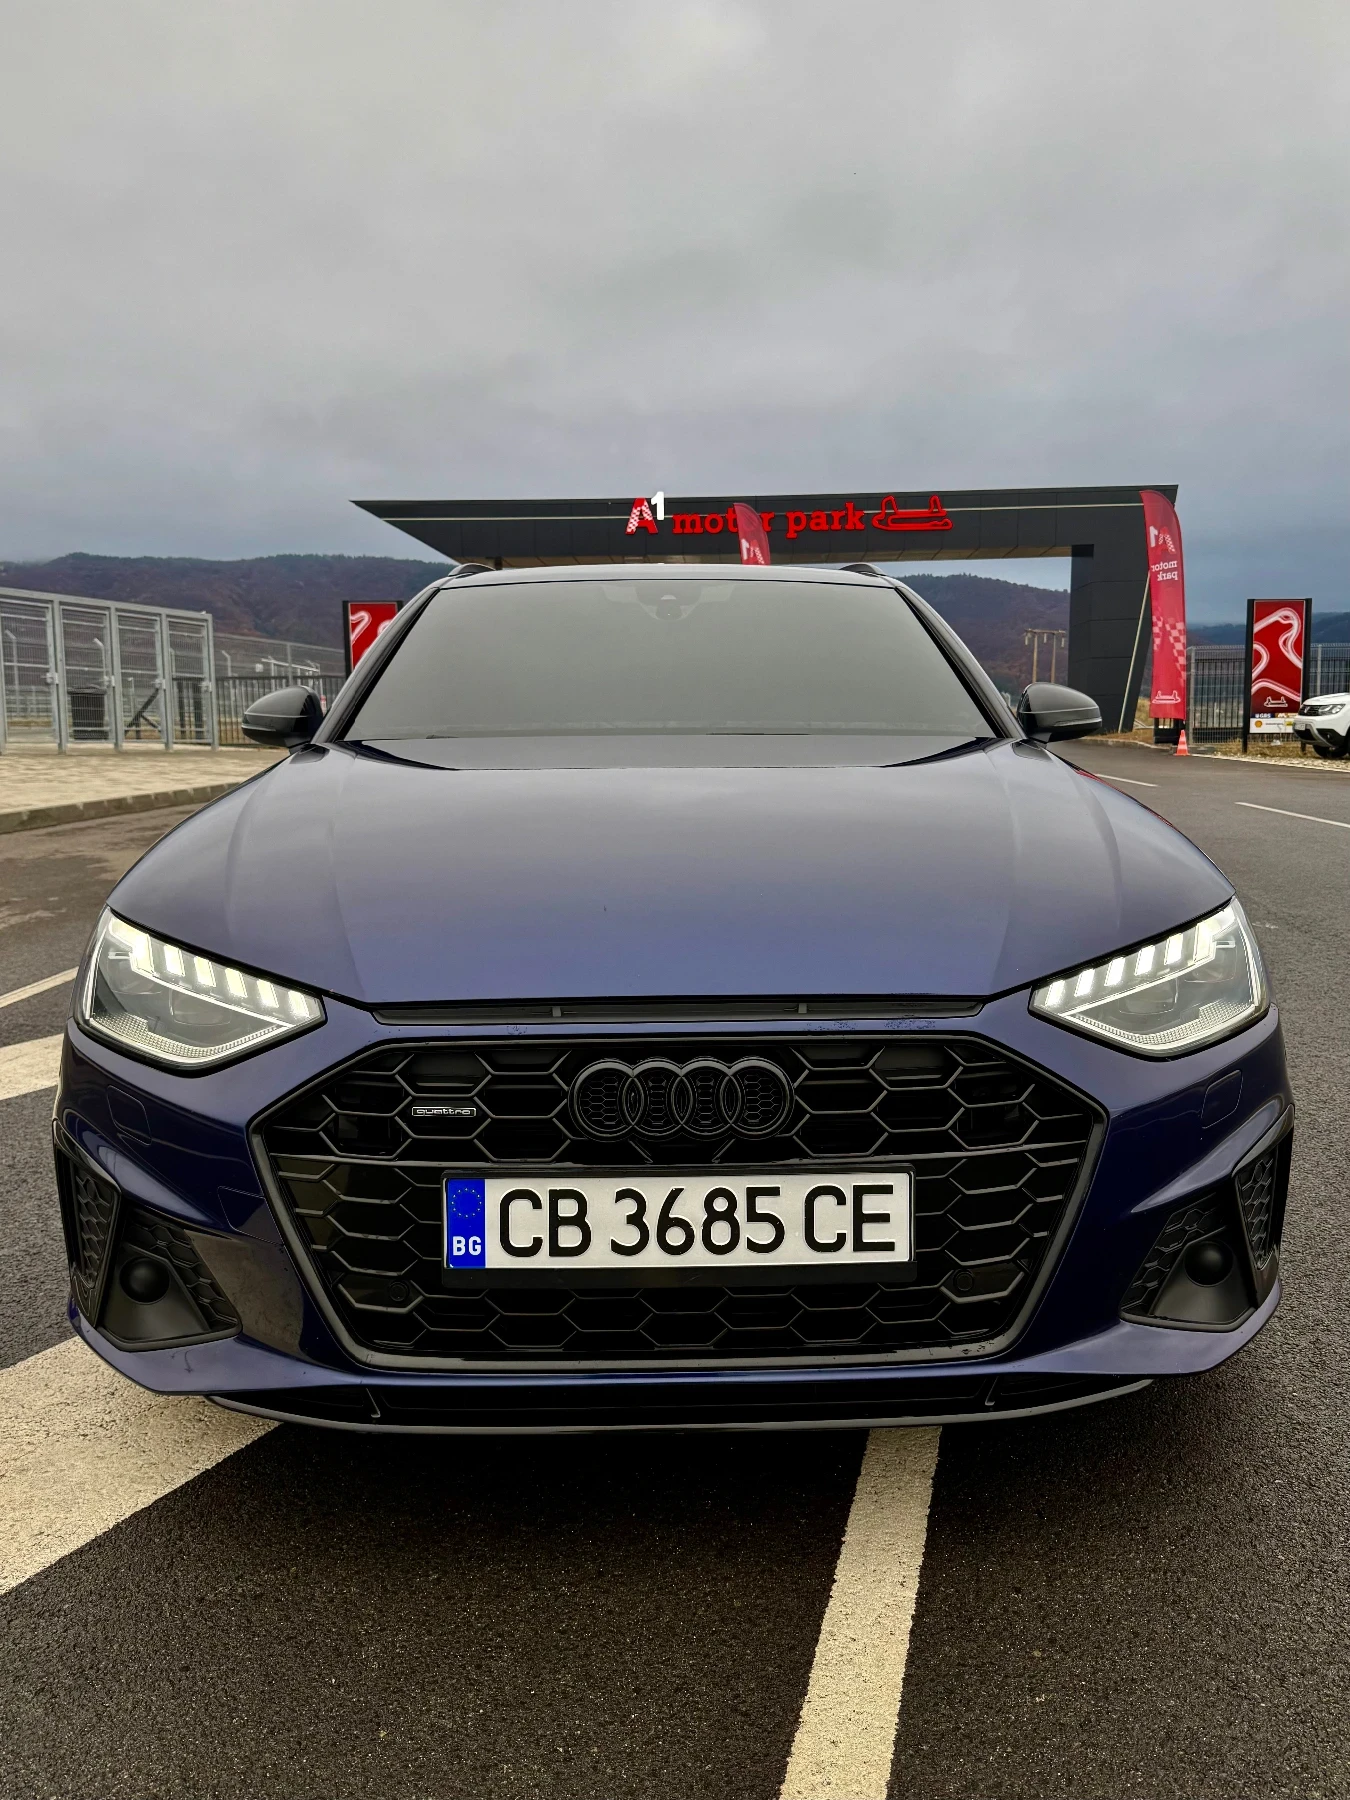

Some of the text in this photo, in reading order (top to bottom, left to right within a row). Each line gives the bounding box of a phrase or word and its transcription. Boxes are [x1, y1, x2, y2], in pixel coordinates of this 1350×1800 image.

[672, 507, 775, 534] motr
[785, 502, 865, 538] park
[416, 1108, 471, 1116] quattro
[499, 1184, 896, 1257] CB 3685 CE
[452, 1236, 482, 1256] BG
